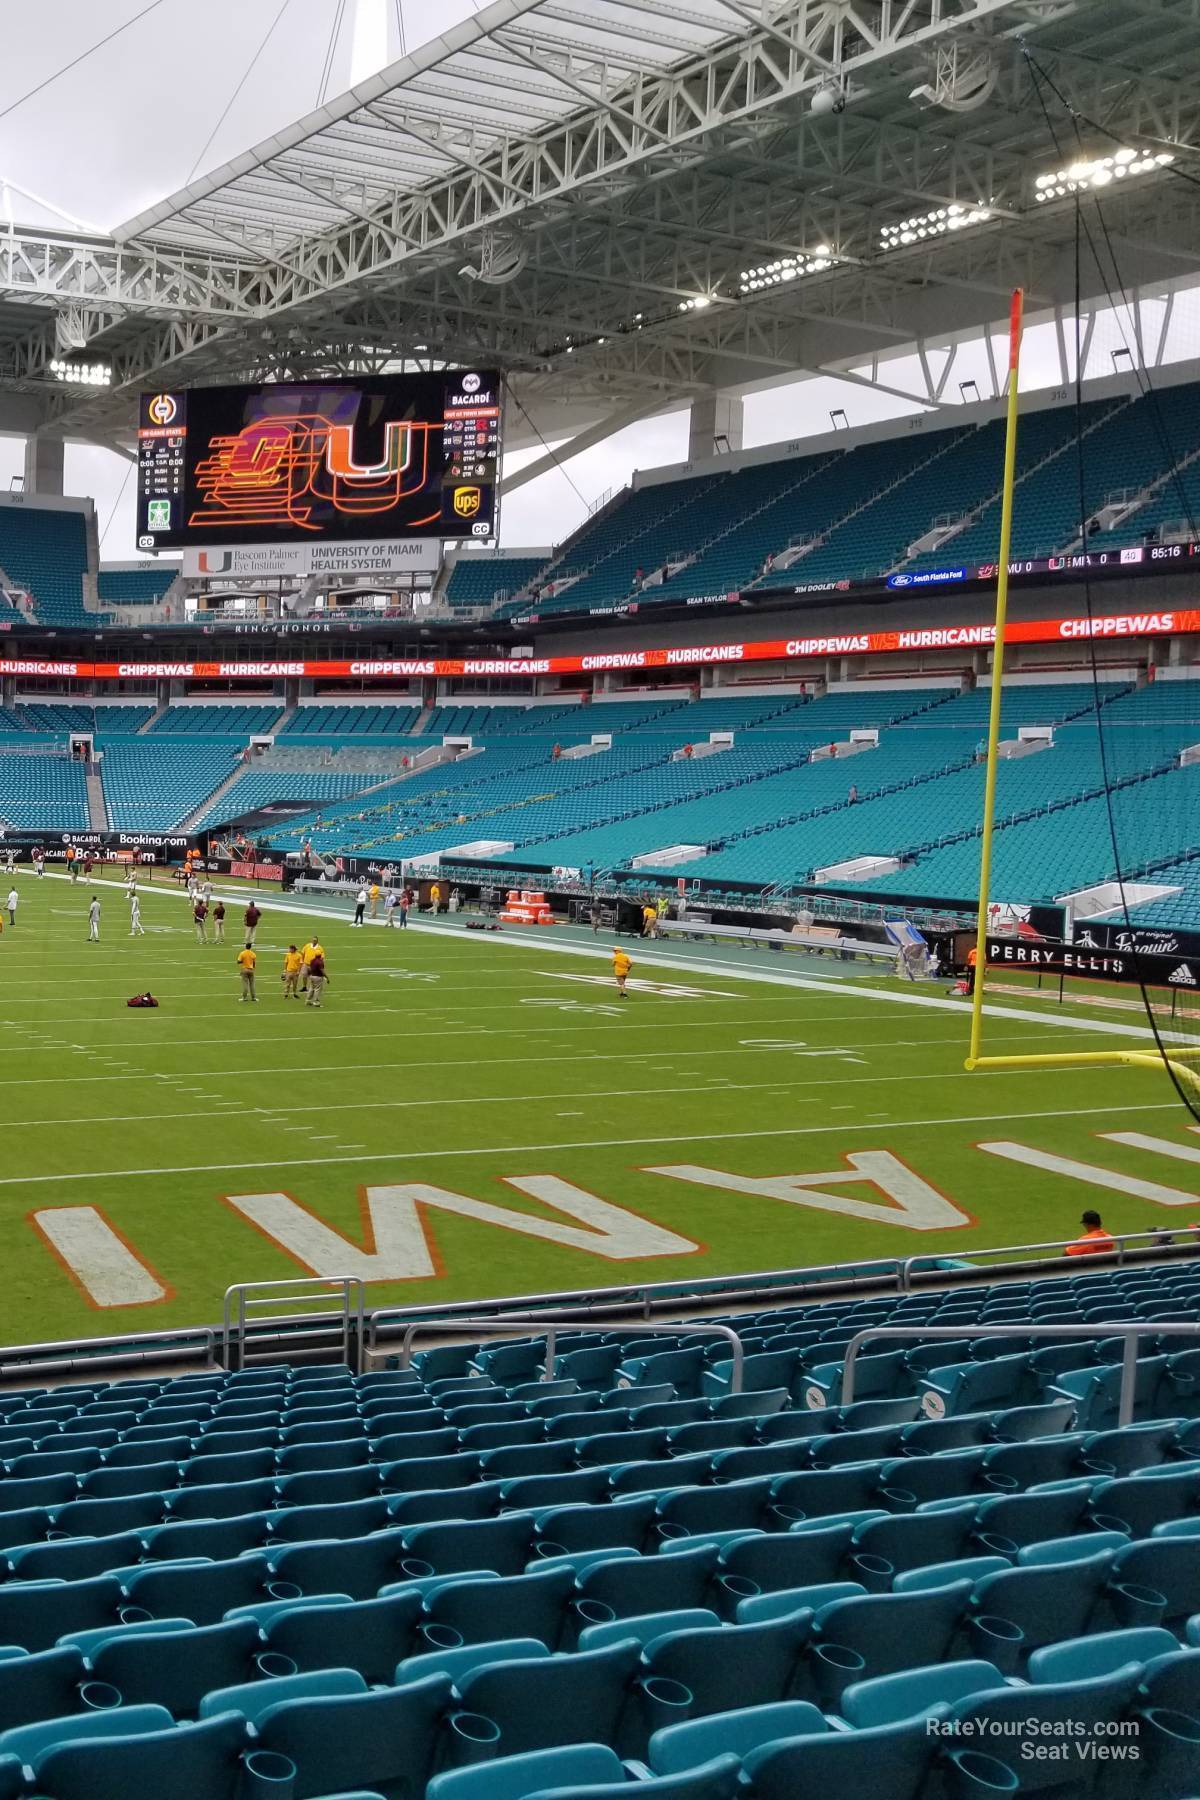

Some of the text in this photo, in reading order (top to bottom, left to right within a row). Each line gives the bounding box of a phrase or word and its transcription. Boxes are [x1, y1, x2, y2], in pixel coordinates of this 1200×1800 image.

[452, 391, 490, 405] BACARDÍ
[456, 495, 478, 513] ups
[473, 525, 488, 534] CC
[140, 537, 154, 546] CC
[234, 549, 300, 561] Bascom Palmer
[311, 544, 423, 558] UNIVERSITY OF MIAMI
[1125, 552, 1136, 560] 40
[1152, 546, 1180, 558] 85:16
[311, 558, 392, 570] HEALTH SYSTEM
[1100, 554, 1106, 563] 0
[234, 560, 286, 573] Eye Institute
[1025, 562, 1032, 571] 0
[950, 570, 962, 578] Ford
[808, 583, 836, 591] DOOLEY
[235, 625, 269, 633] RING
[282, 625, 330, 633] HONOR
[1059, 614, 1174, 637] CHIPPEWAS
[786, 636, 868, 655] CHIPPEWAS
[898, 626, 997, 647] HURRICANES
[581, 652, 645, 669] CHIPPEWAS
[667, 645, 743, 663] HURRICANES
[0, 661, 77, 675] HURRICANES
[118, 664, 193, 676] CHIPPEWAS
[220, 663, 304, 675] HURRICANES
[350, 662, 434, 675] CHIPPEWAS
[464, 659, 549, 674] HURRICANES
[119, 834, 187, 846] Booking.com
[1146, 931, 1173, 939] original
[991, 944, 1123, 973] PERRY ELLIS
[1168, 976, 1196, 985] adidas
